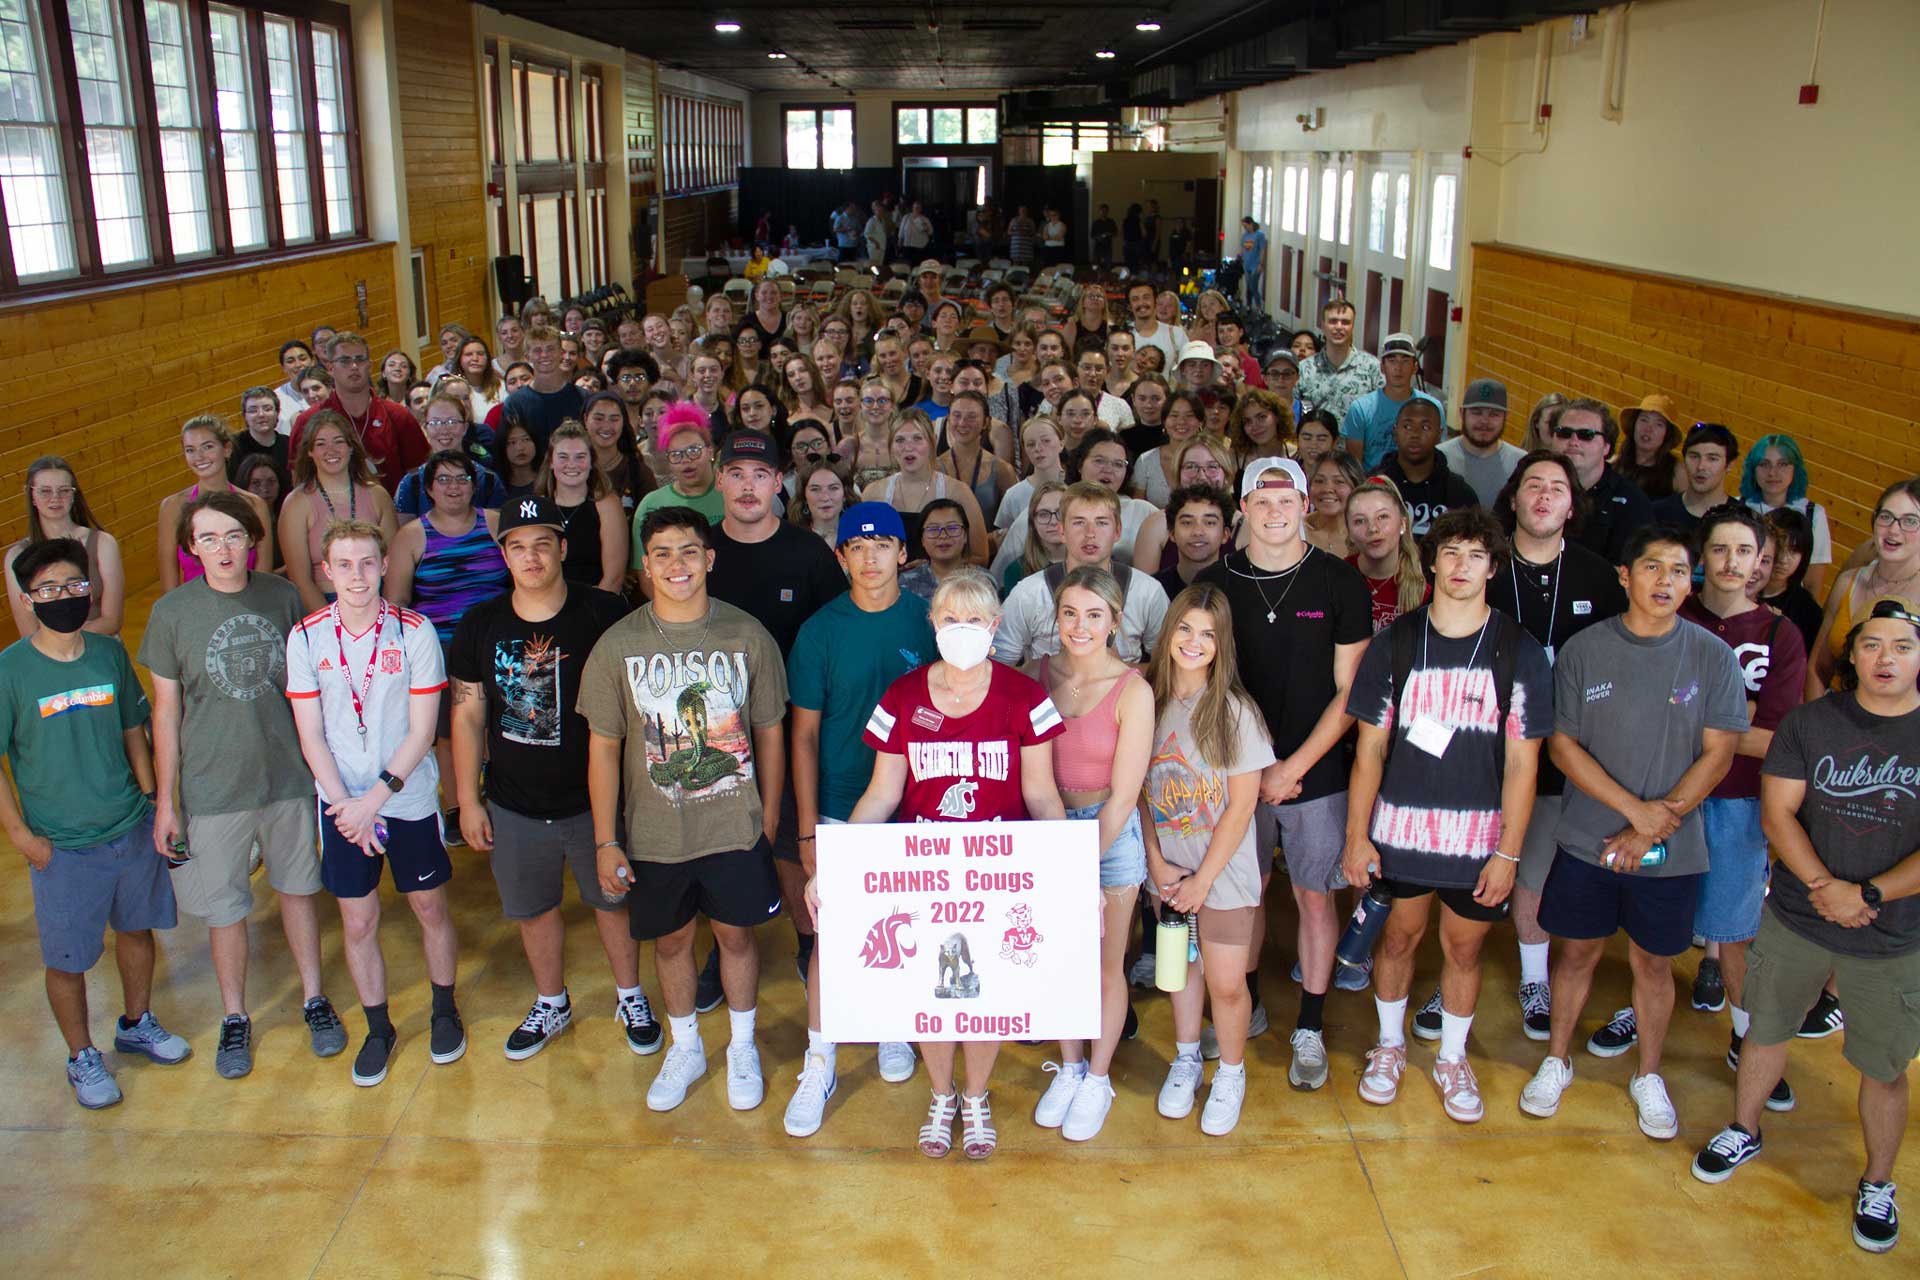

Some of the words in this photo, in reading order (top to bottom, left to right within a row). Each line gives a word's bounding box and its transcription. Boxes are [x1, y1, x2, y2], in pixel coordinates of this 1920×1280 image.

[624, 650, 748, 711] POISON
[64, 692, 106, 706] Columbia
[1586, 690, 1610, 703] POWER
[977, 740, 1009, 781] STATE
[905, 835, 950, 857] New
[963, 834, 1013, 857] WSU
[864, 870, 950, 894] CAHNRS
[965, 869, 1034, 893] Cougs
[930, 901, 985, 923] 2022
[915, 1012, 942, 1034] Go
[955, 1012, 1031, 1036] Cougs!
